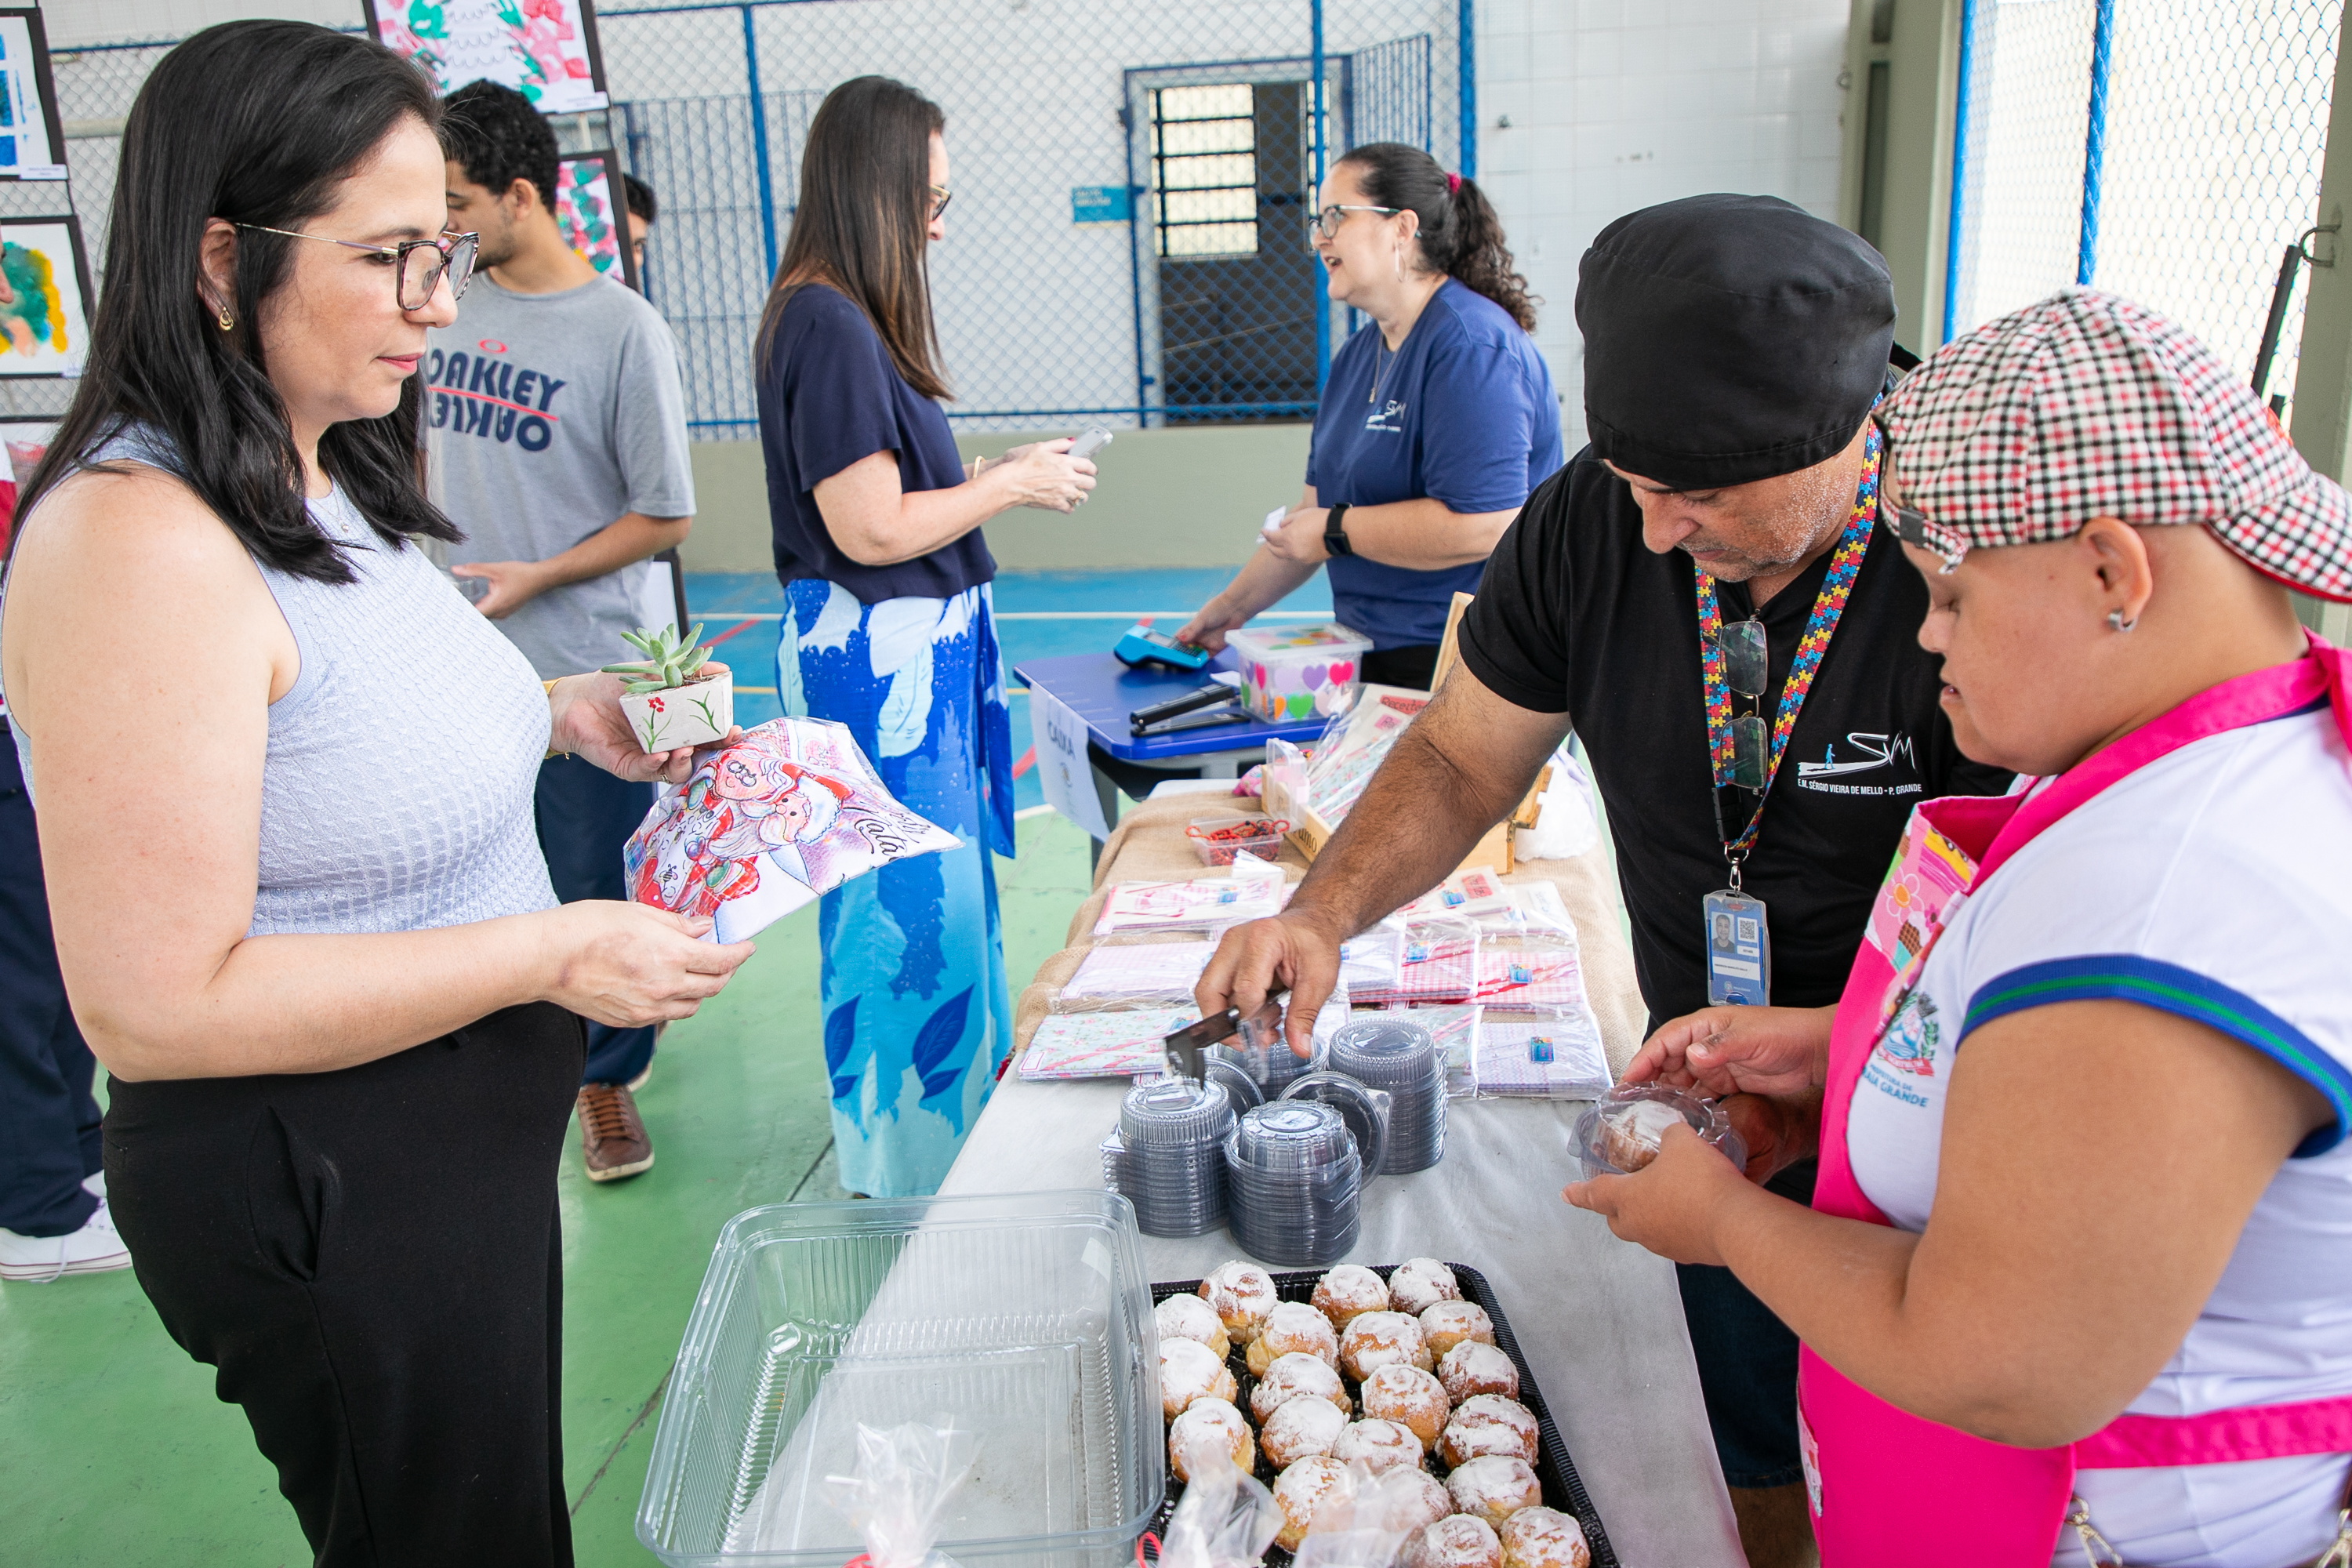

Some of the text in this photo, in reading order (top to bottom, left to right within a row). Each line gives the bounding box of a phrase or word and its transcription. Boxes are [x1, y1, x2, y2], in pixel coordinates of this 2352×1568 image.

[1798, 778, 1809, 789] E.M.
[1809, 779, 1828, 793] SÉRGIO
[1829, 784, 1849, 794] VIEIRA
[1850, 786, 1860, 794] DE
[1860, 786, 1883, 795] MELLO
[1889, 786, 1895, 796] P.
[1896, 783, 1922, 795] GRANDE
[1880, 1081, 1929, 1108] GRANDE
